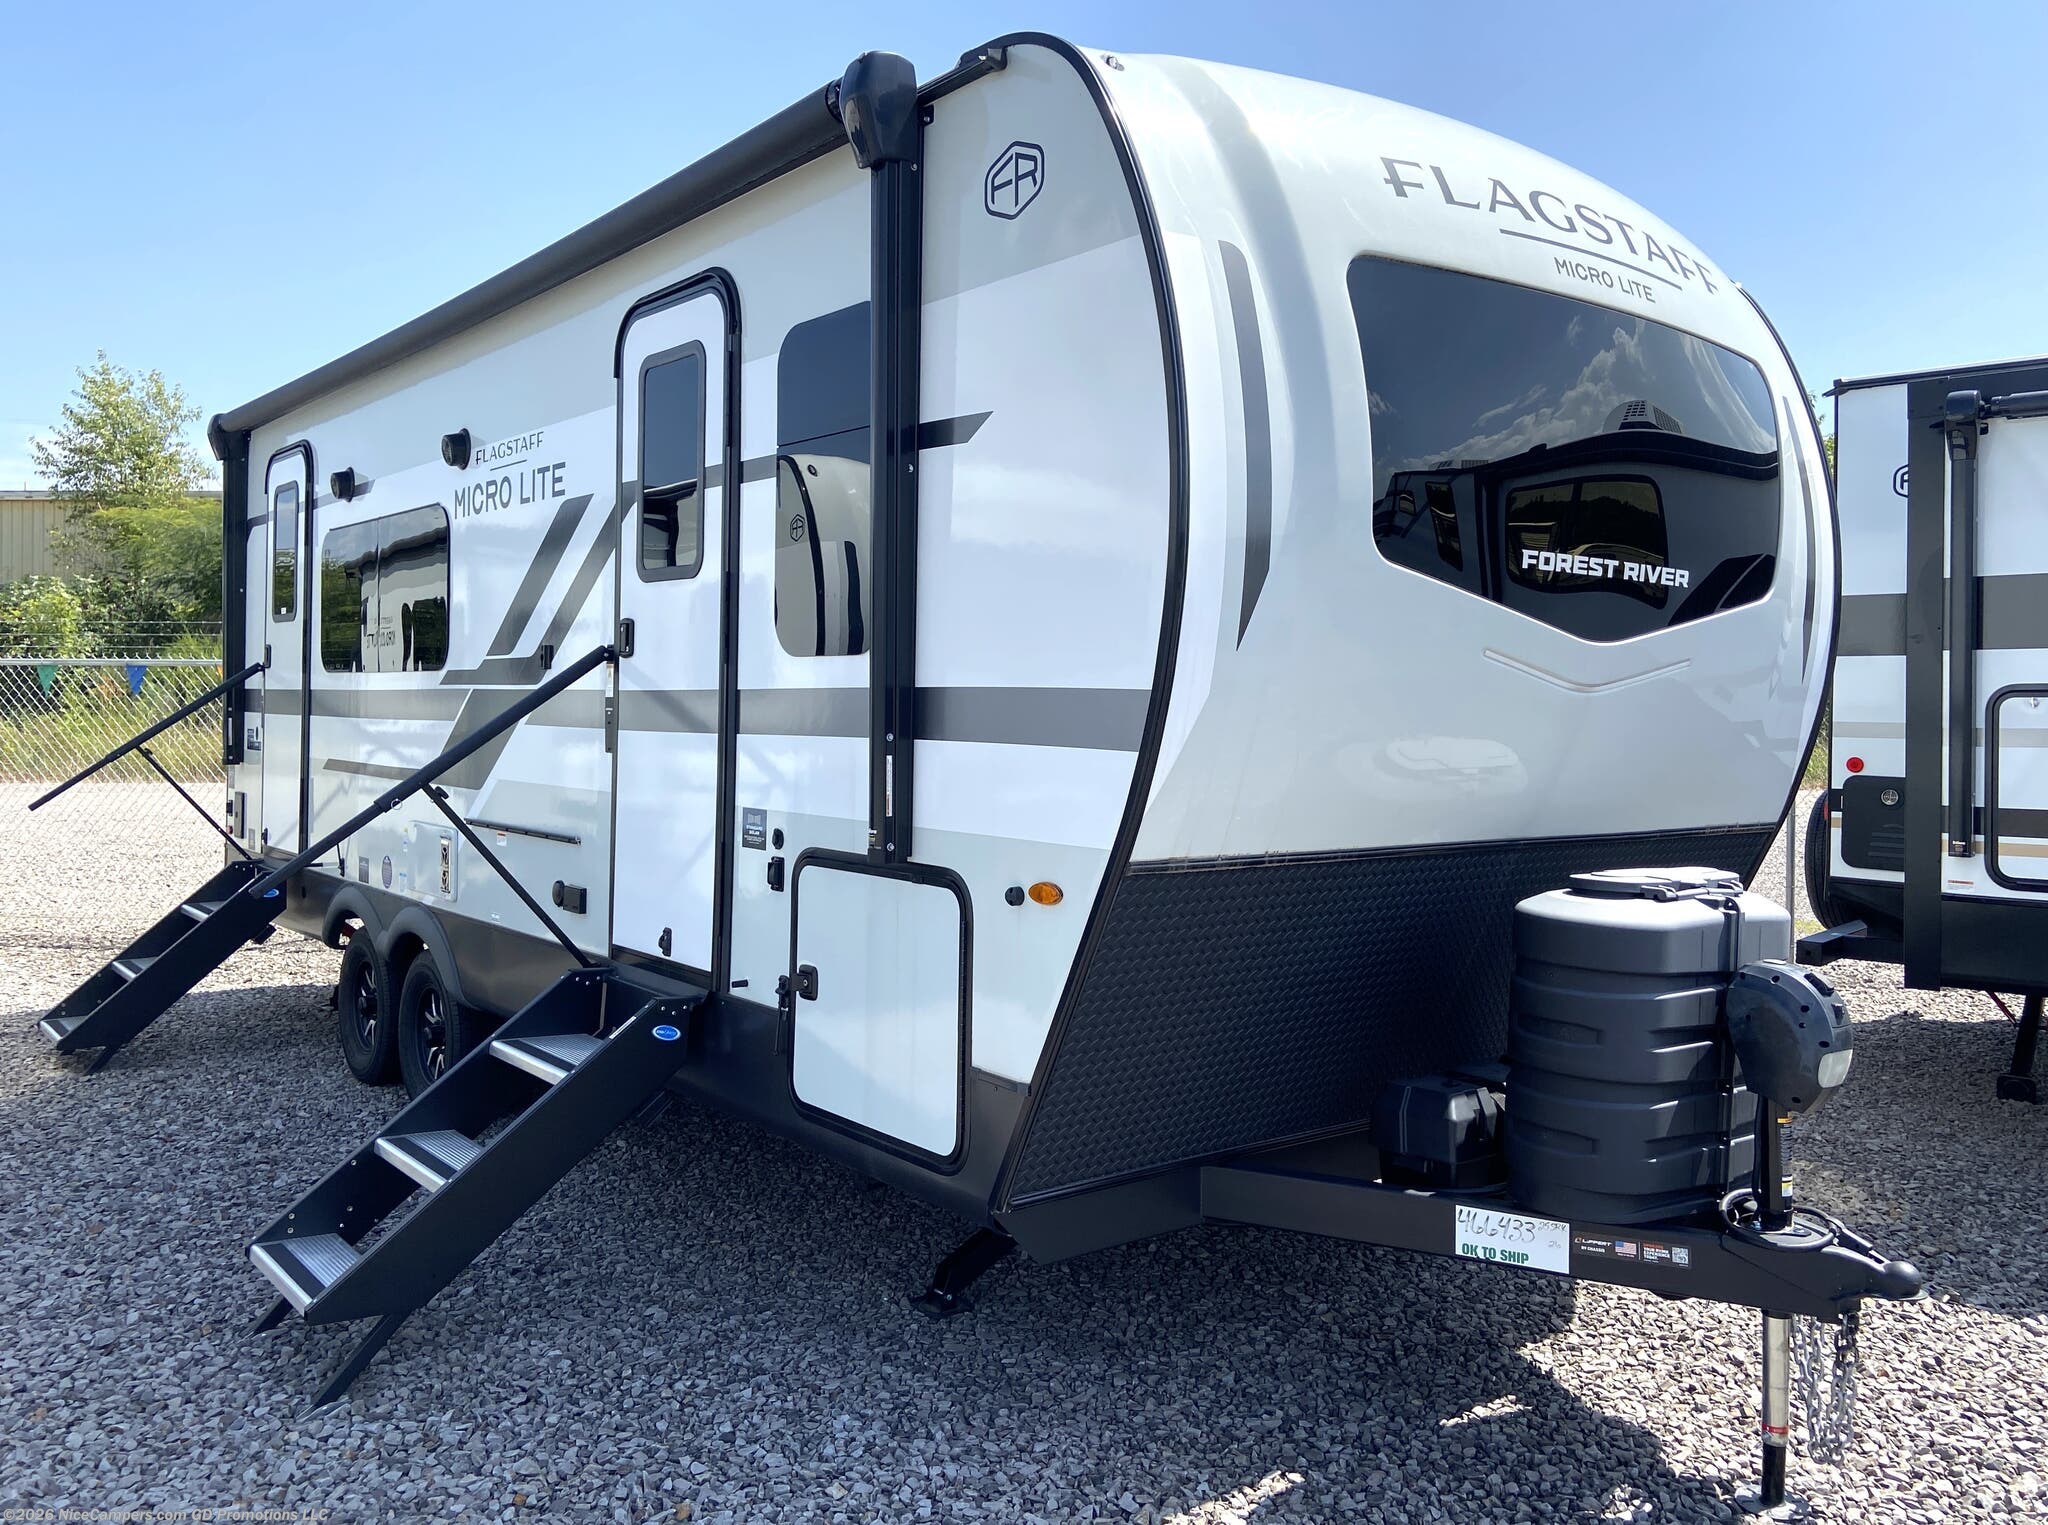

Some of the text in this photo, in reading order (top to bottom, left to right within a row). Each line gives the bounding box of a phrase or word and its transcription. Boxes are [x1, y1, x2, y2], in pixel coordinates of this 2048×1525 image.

[1379, 155, 1720, 295] FLAGSTAFF
[1553, 256, 1656, 303] MICRO LITE
[475, 431, 545, 465] FLAGSTAFF
[454, 461, 566, 520] MICRO LITE
[1521, 549, 1690, 588] FOREST RIVER
[1457, 1208, 1536, 1243] 466433
[1461, 1243, 1529, 1264] OK TO SHIP
